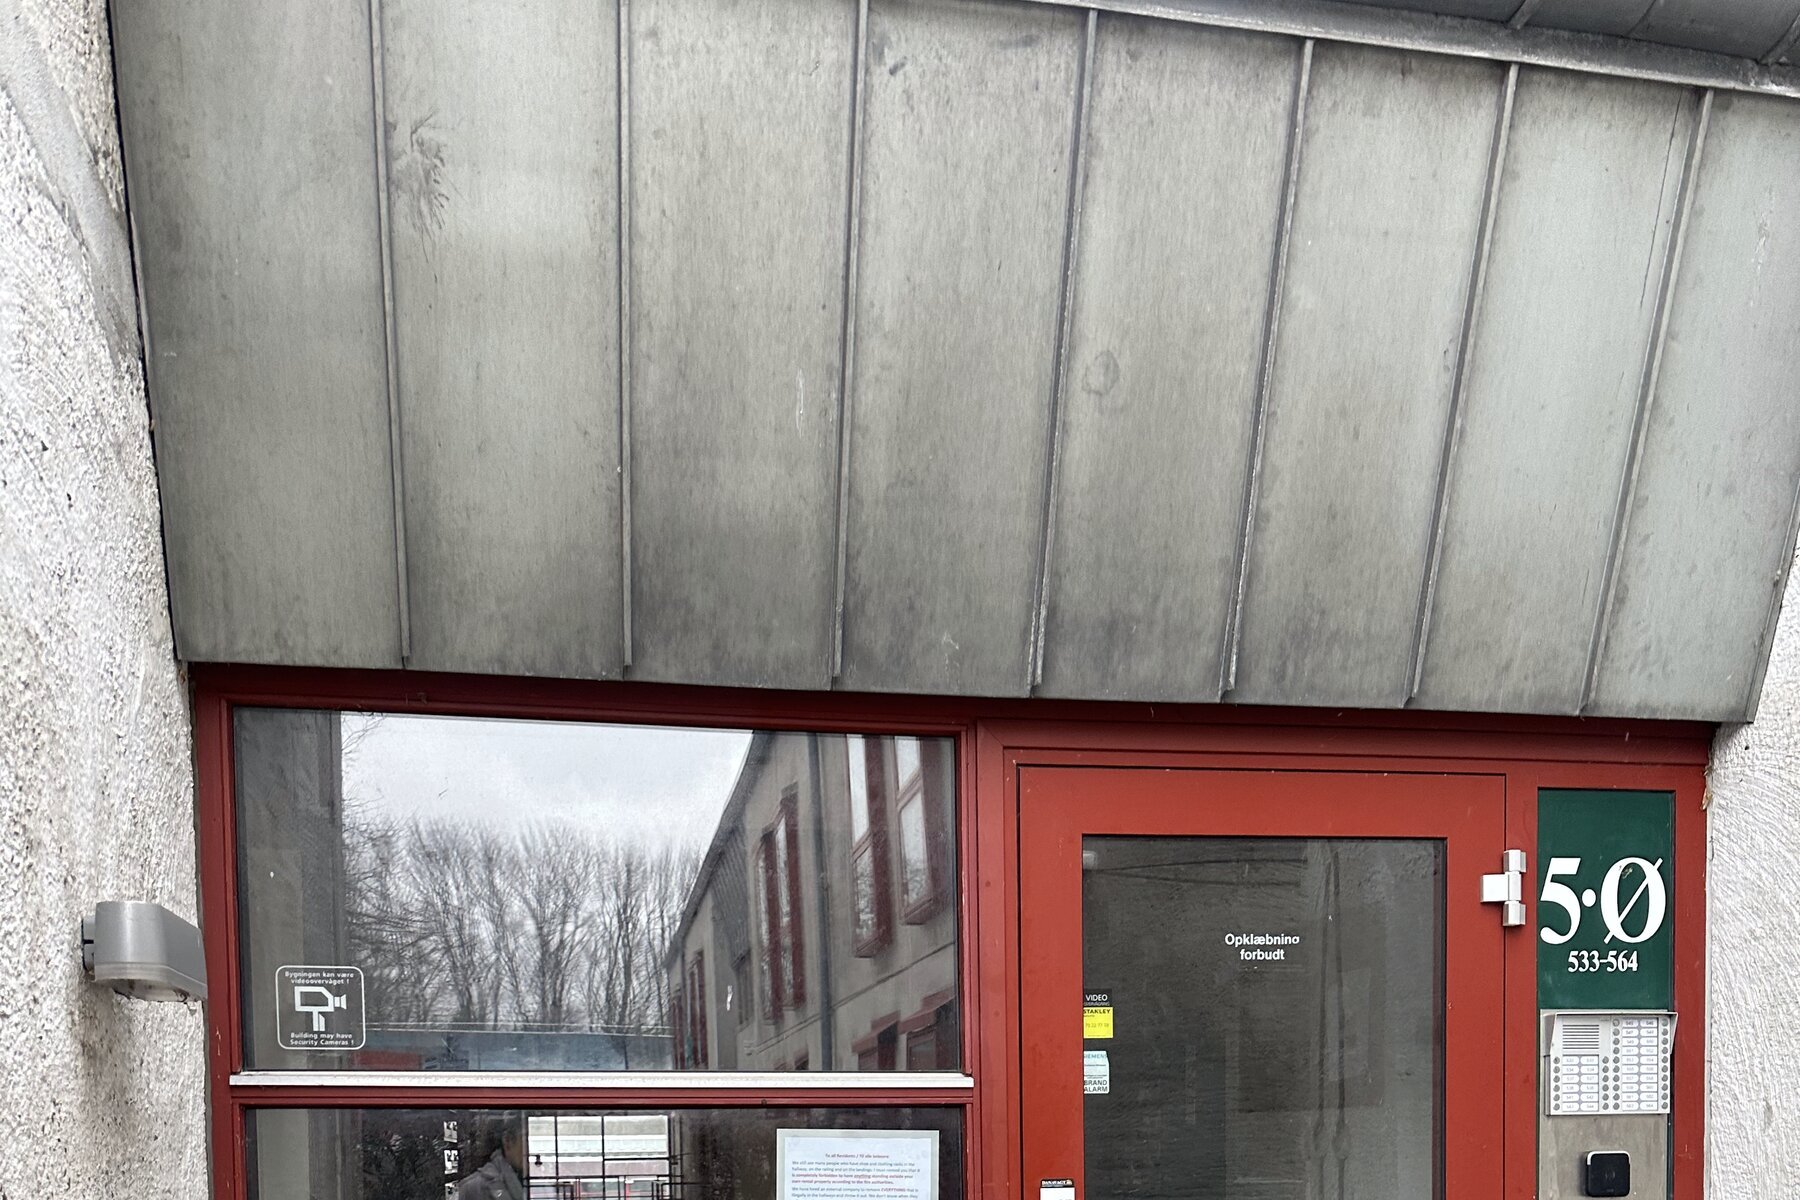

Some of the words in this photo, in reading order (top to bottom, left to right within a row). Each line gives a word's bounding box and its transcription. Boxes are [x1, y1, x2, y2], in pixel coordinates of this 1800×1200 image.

[1240, 948, 1285, 960] forbudt
[1567, 950, 1638, 973] 533-564
[291, 978, 344, 986] videoovervåget
